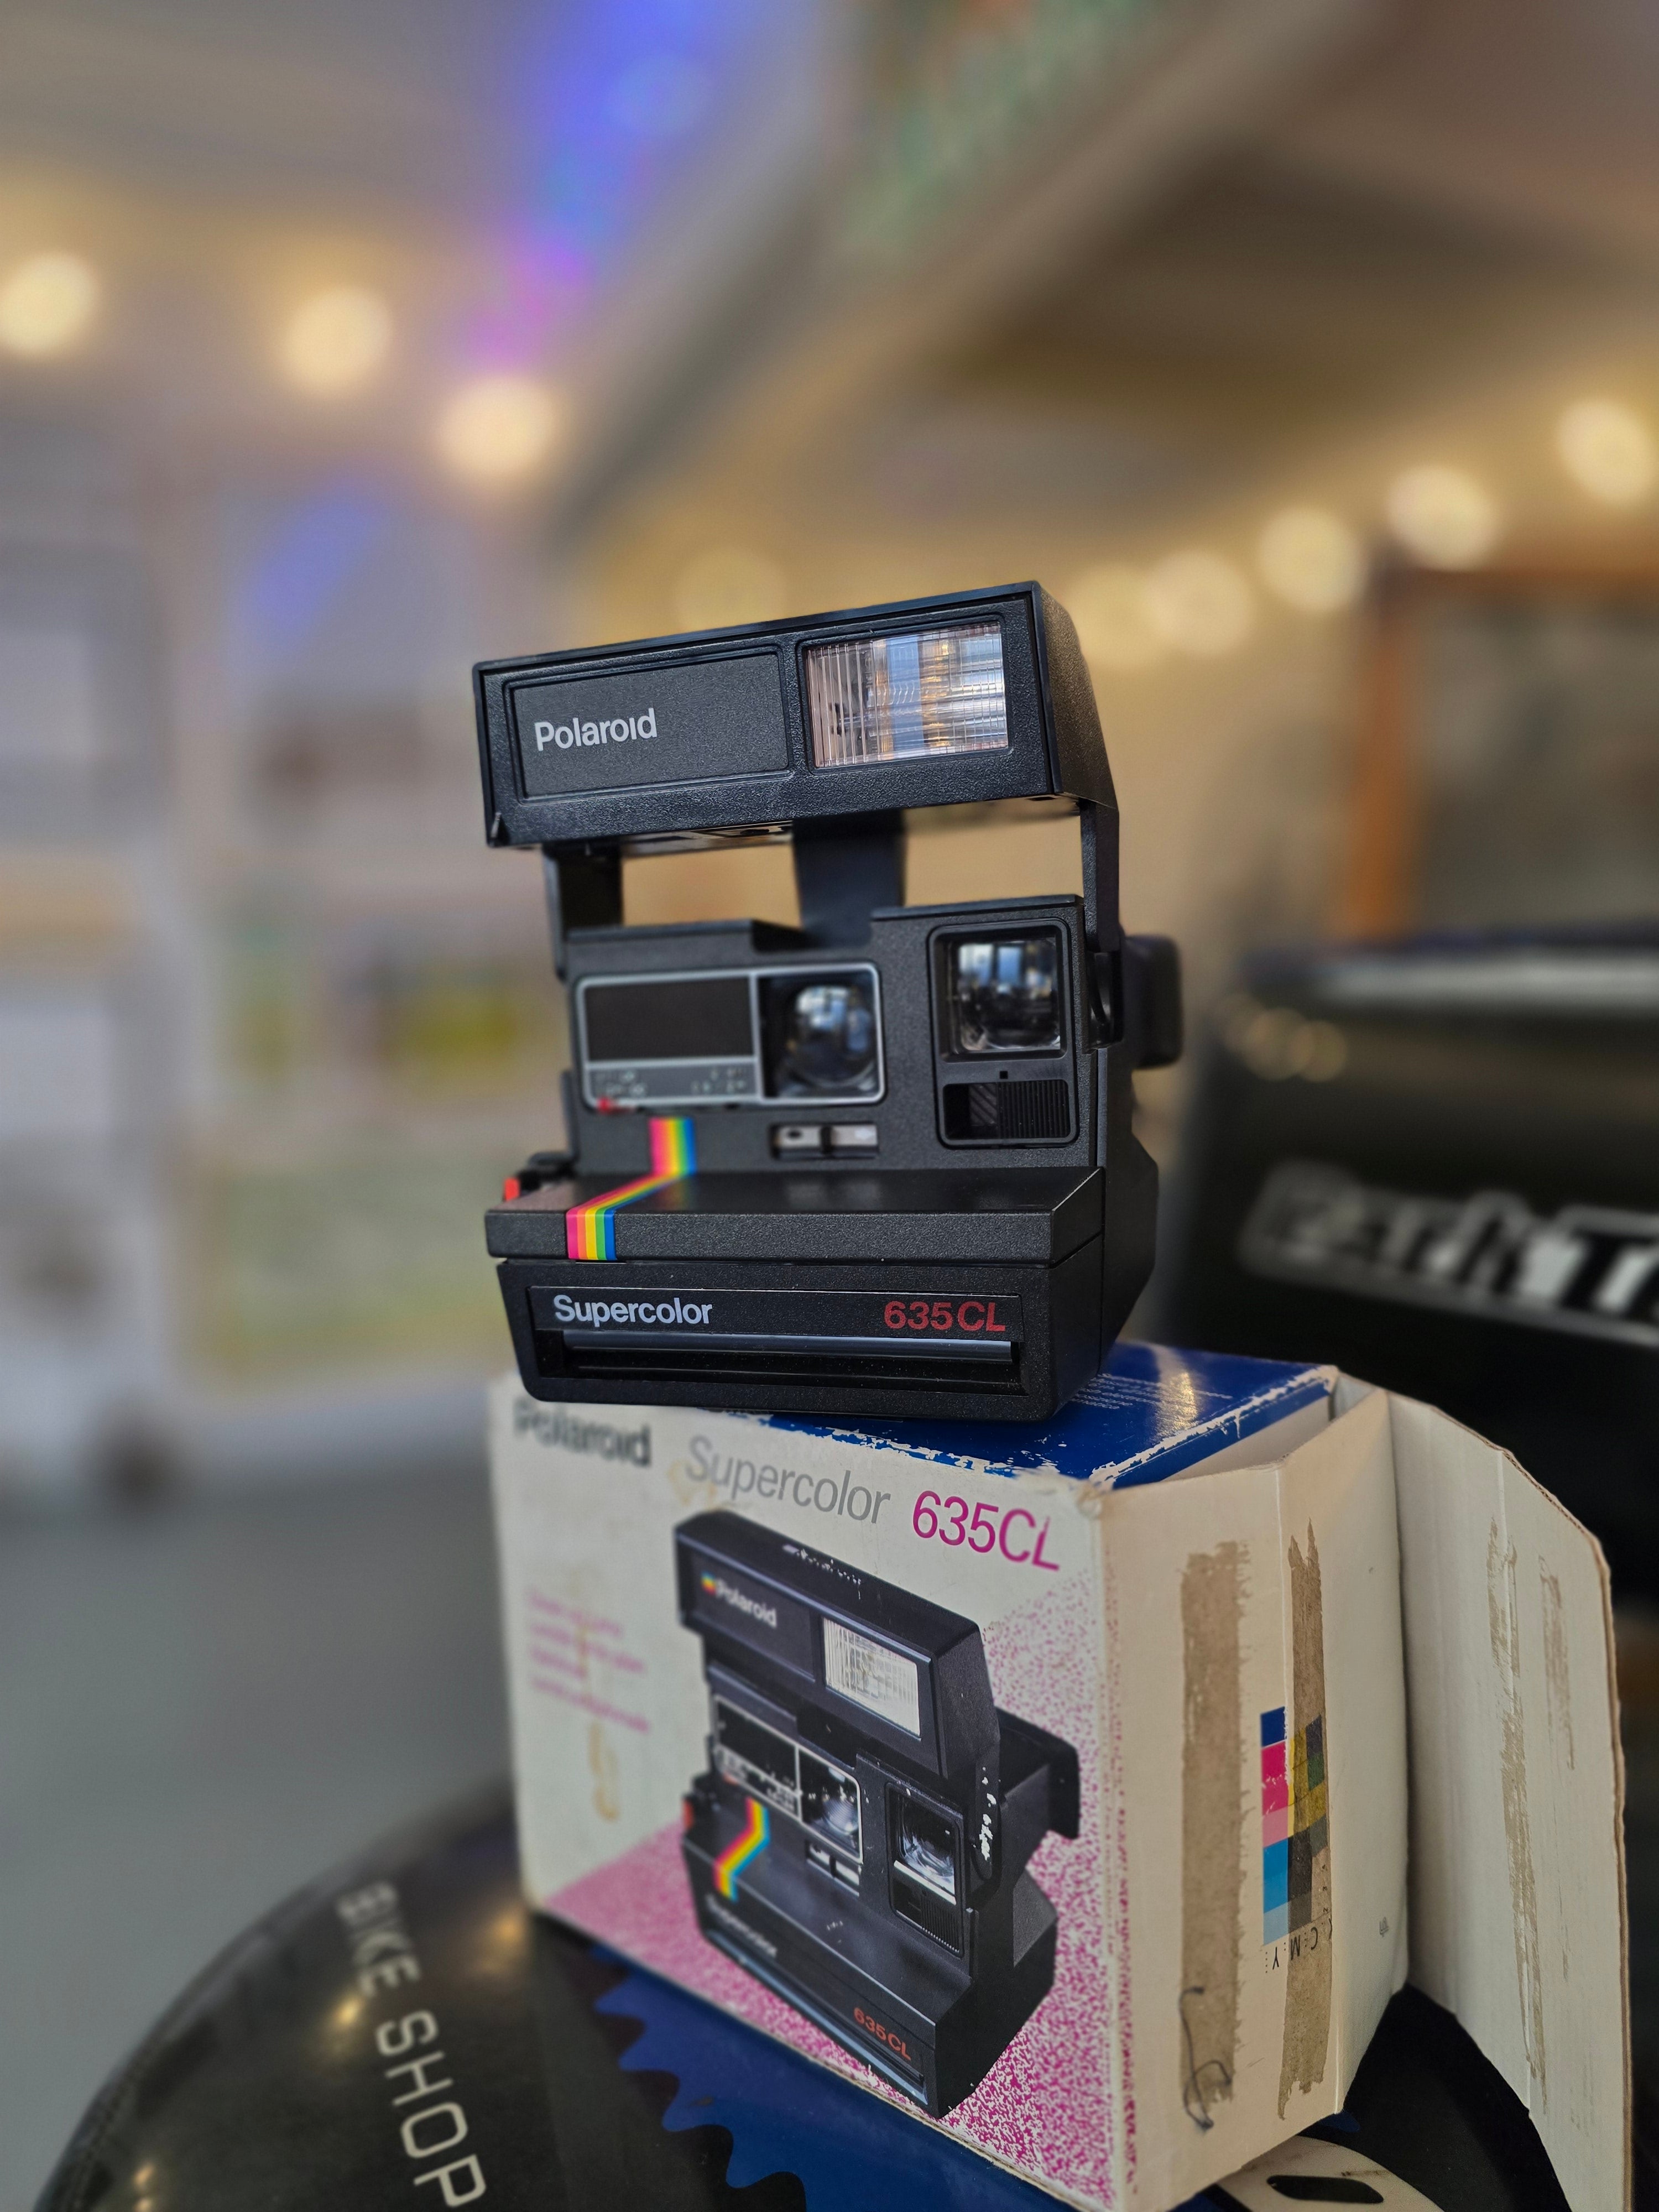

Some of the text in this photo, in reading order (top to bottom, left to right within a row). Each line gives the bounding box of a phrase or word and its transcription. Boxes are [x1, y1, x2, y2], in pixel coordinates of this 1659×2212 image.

[534, 708, 657, 751] Polaroid
[553, 1294, 1006, 1332] Supercolor 635CL
[685, 1434, 891, 1525] Supercolor
[912, 1490, 1060, 1571] 635CL
[338, 1881, 487, 2208] BIKE SHOP
[853, 2007, 912, 2060] 635CL
